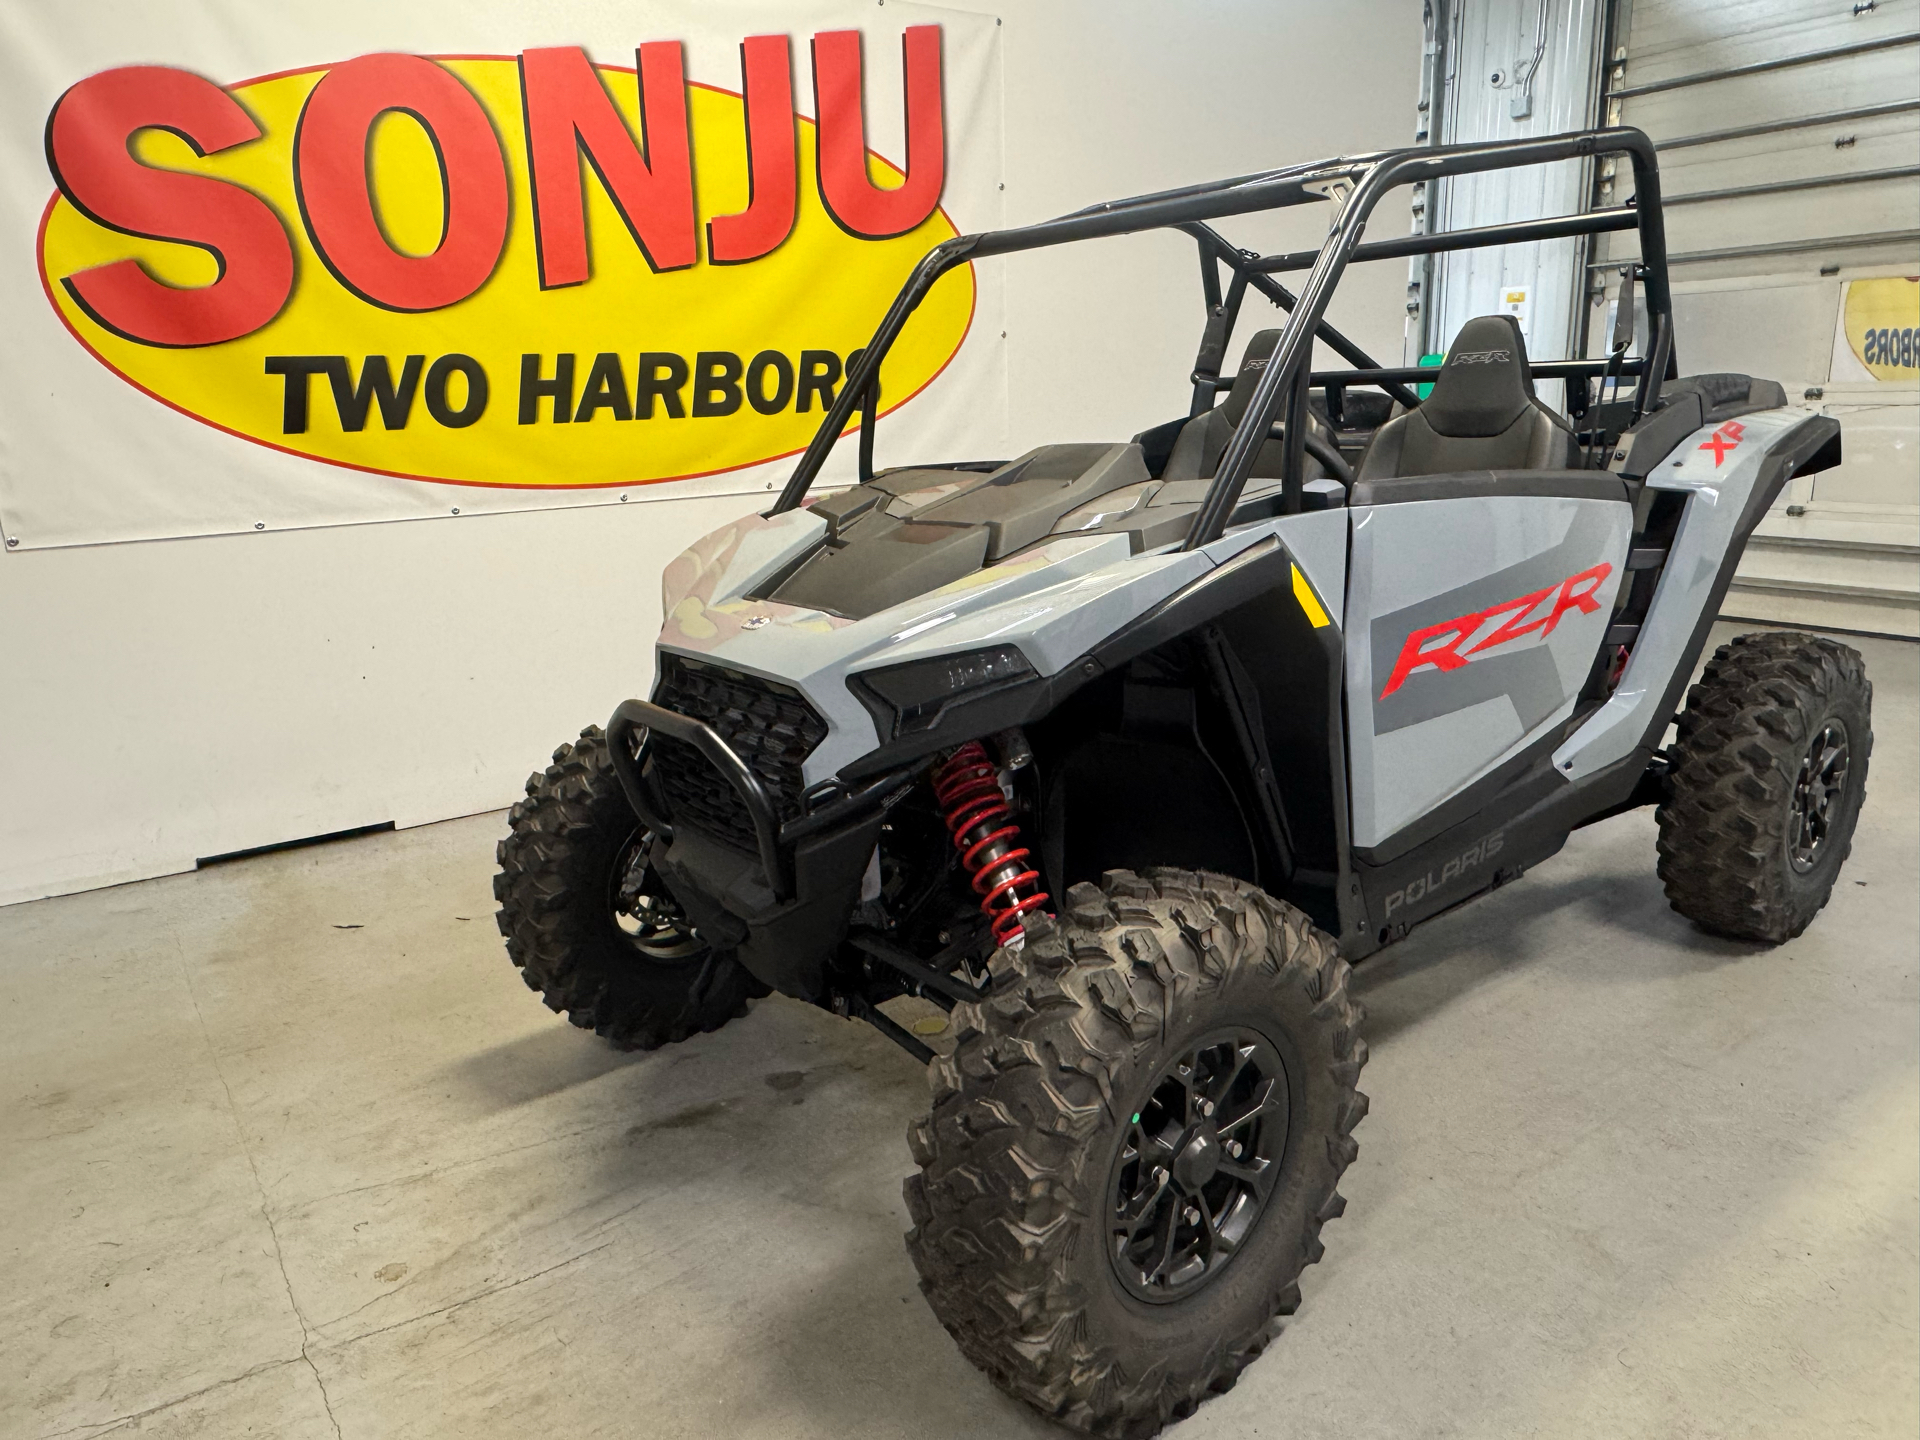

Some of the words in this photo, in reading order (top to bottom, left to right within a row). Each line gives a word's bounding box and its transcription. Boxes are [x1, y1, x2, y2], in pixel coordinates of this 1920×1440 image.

[46, 25, 946, 348] SONJU
[264, 353, 489, 435] TWO
[1698, 420, 1747, 469] XP
[1379, 562, 1613, 702] RZR
[1385, 831, 1504, 919] POLARIS
